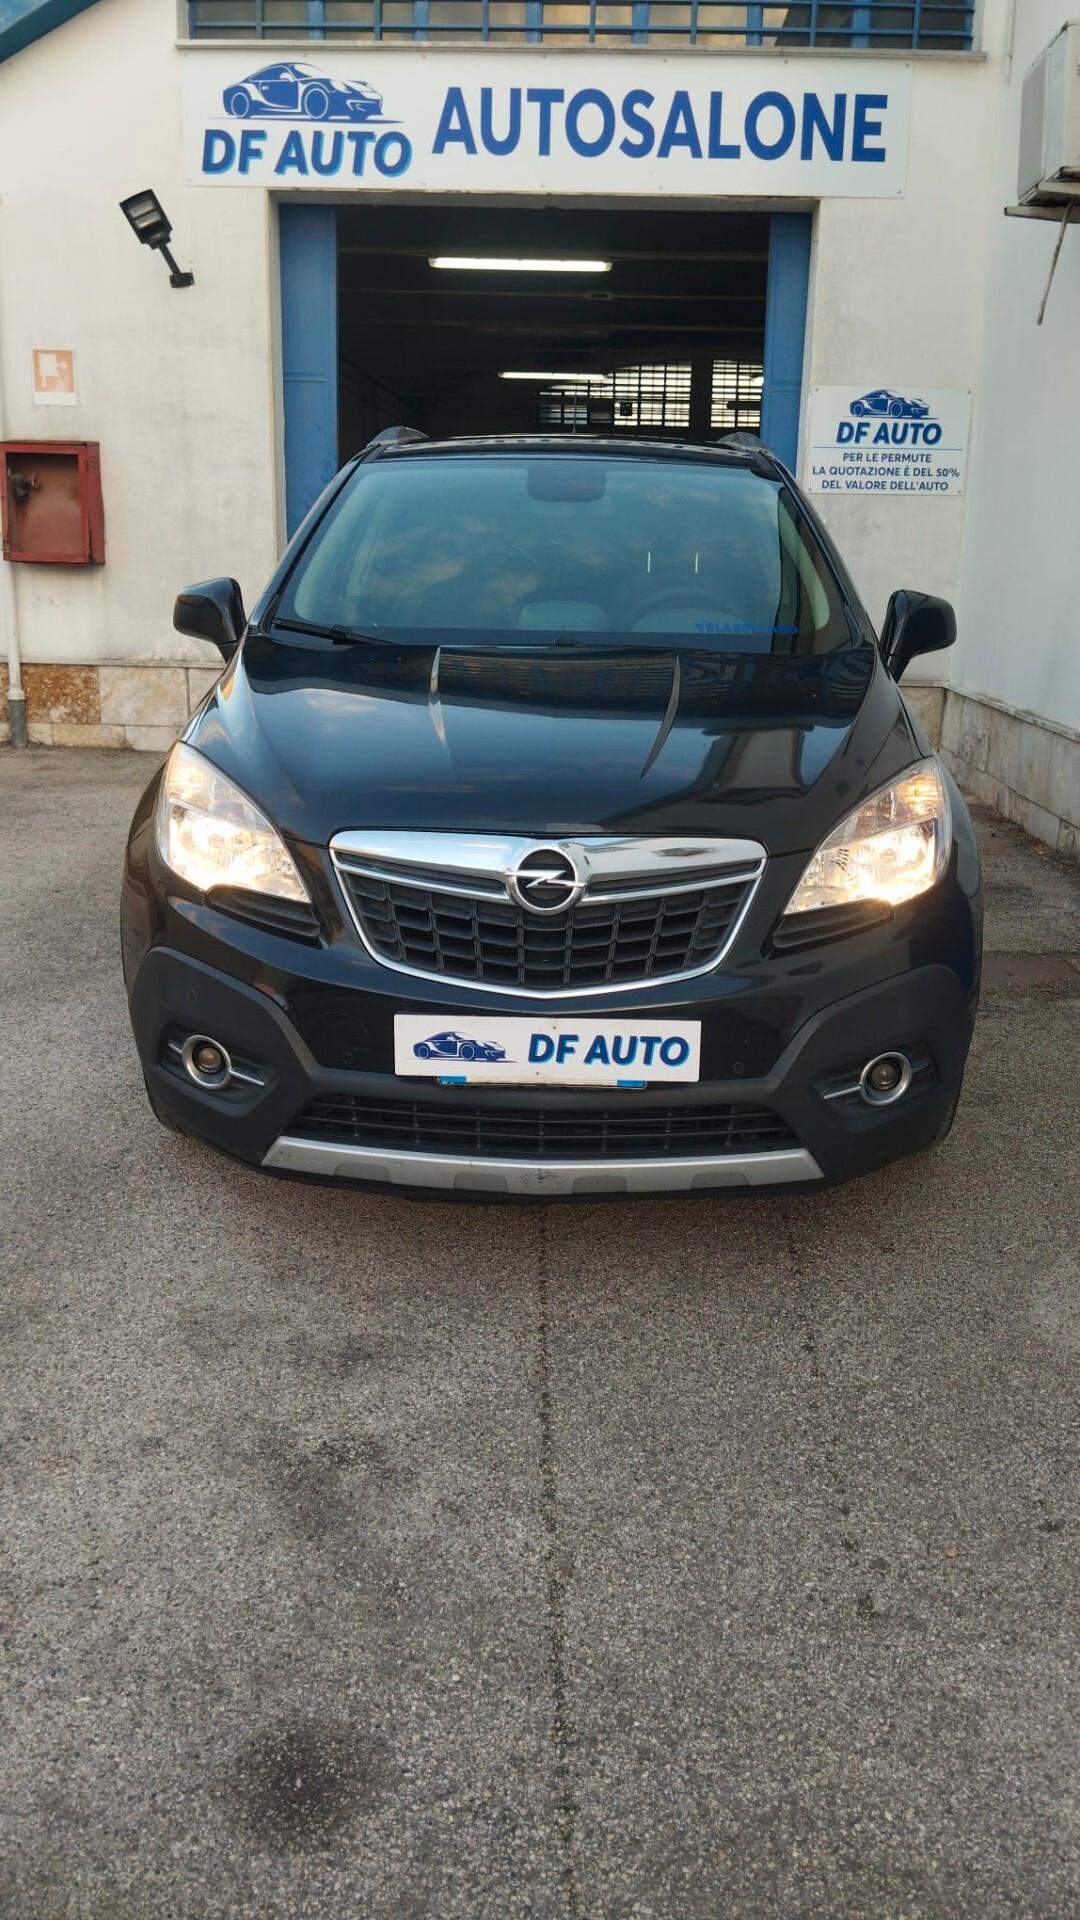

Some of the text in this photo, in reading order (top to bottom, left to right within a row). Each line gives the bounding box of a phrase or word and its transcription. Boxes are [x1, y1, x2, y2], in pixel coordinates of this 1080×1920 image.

[432, 87, 888, 162] AUTOSALONE
[202, 129, 412, 177] DF AUTO
[836, 422, 942, 445] DF AUTO
[843, 453, 931, 463] PER LE PERMUTE
[813, 465, 960, 477] LA QUOTAZIONE È DEL 50%
[822, 480, 948, 491] DEL VALORE DELL'AUTO
[528, 1034, 689, 1066] DF AUTO
